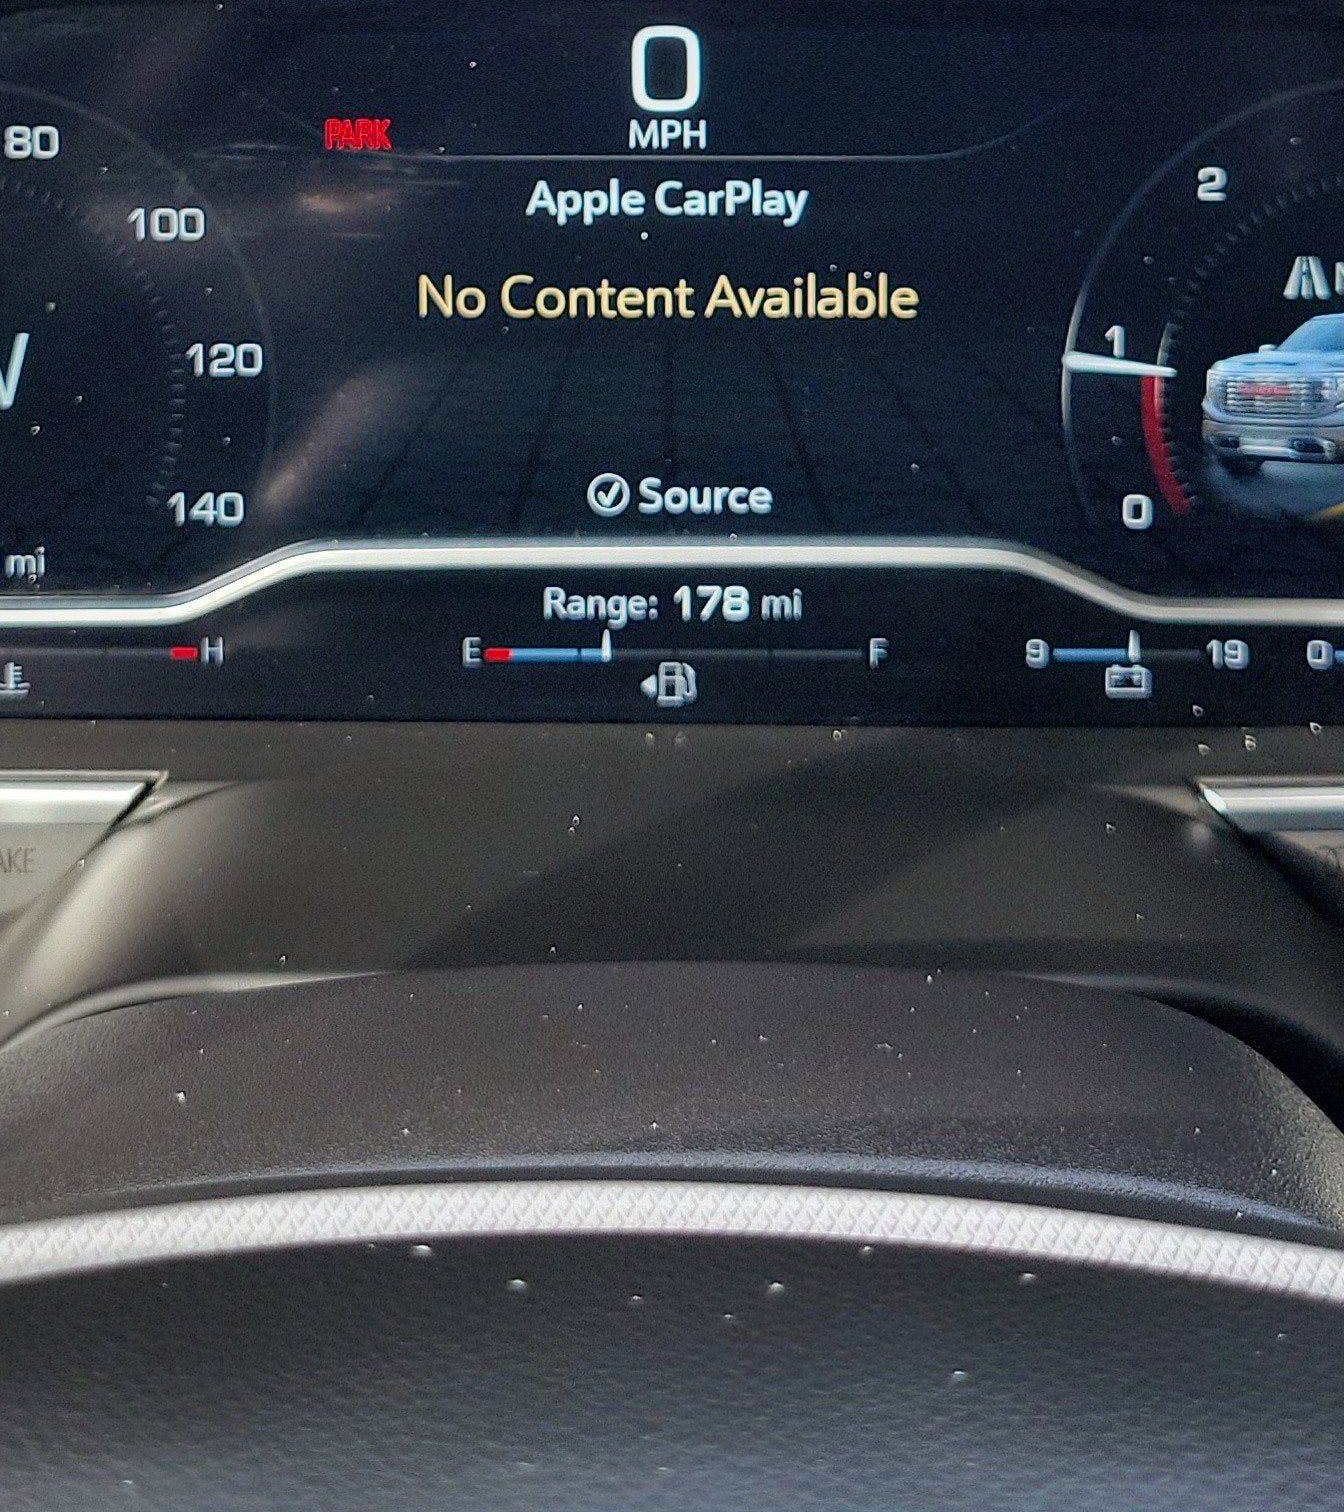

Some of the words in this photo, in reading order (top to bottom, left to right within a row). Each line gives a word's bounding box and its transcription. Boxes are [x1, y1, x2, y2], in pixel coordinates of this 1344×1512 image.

[630, 25, 701, 112] 0
[4, 124, 59, 160] 80
[325, 117, 392, 151] PARK
[628, 119, 706, 150] MPH
[1197, 166, 1228, 202] 2
[525, 178, 645, 226] Apple
[654, 178, 809, 227] CarPlay
[127, 207, 205, 242] 100
[418, 274, 487, 320] No
[500, 274, 694, 320] Content
[704, 271, 920, 320] Available
[1103, 325, 1125, 359] 1
[185, 343, 263, 377] 120
[167, 491, 245, 527] 140
[638, 476, 773, 515] Source
[1121, 494, 1154, 530] 0
[5, 546, 46, 578] mi
[543, 586, 658, 630] Range:
[673, 585, 750, 622] 178
[761, 588, 803, 622] mi
[200, 636, 225, 668] H
[462, 636, 484, 669] E
[868, 637, 889, 670] F
[1025, 638, 1050, 669] 9
[1205, 639, 1249, 670] 19
[1306, 639, 1334, 670] 0
